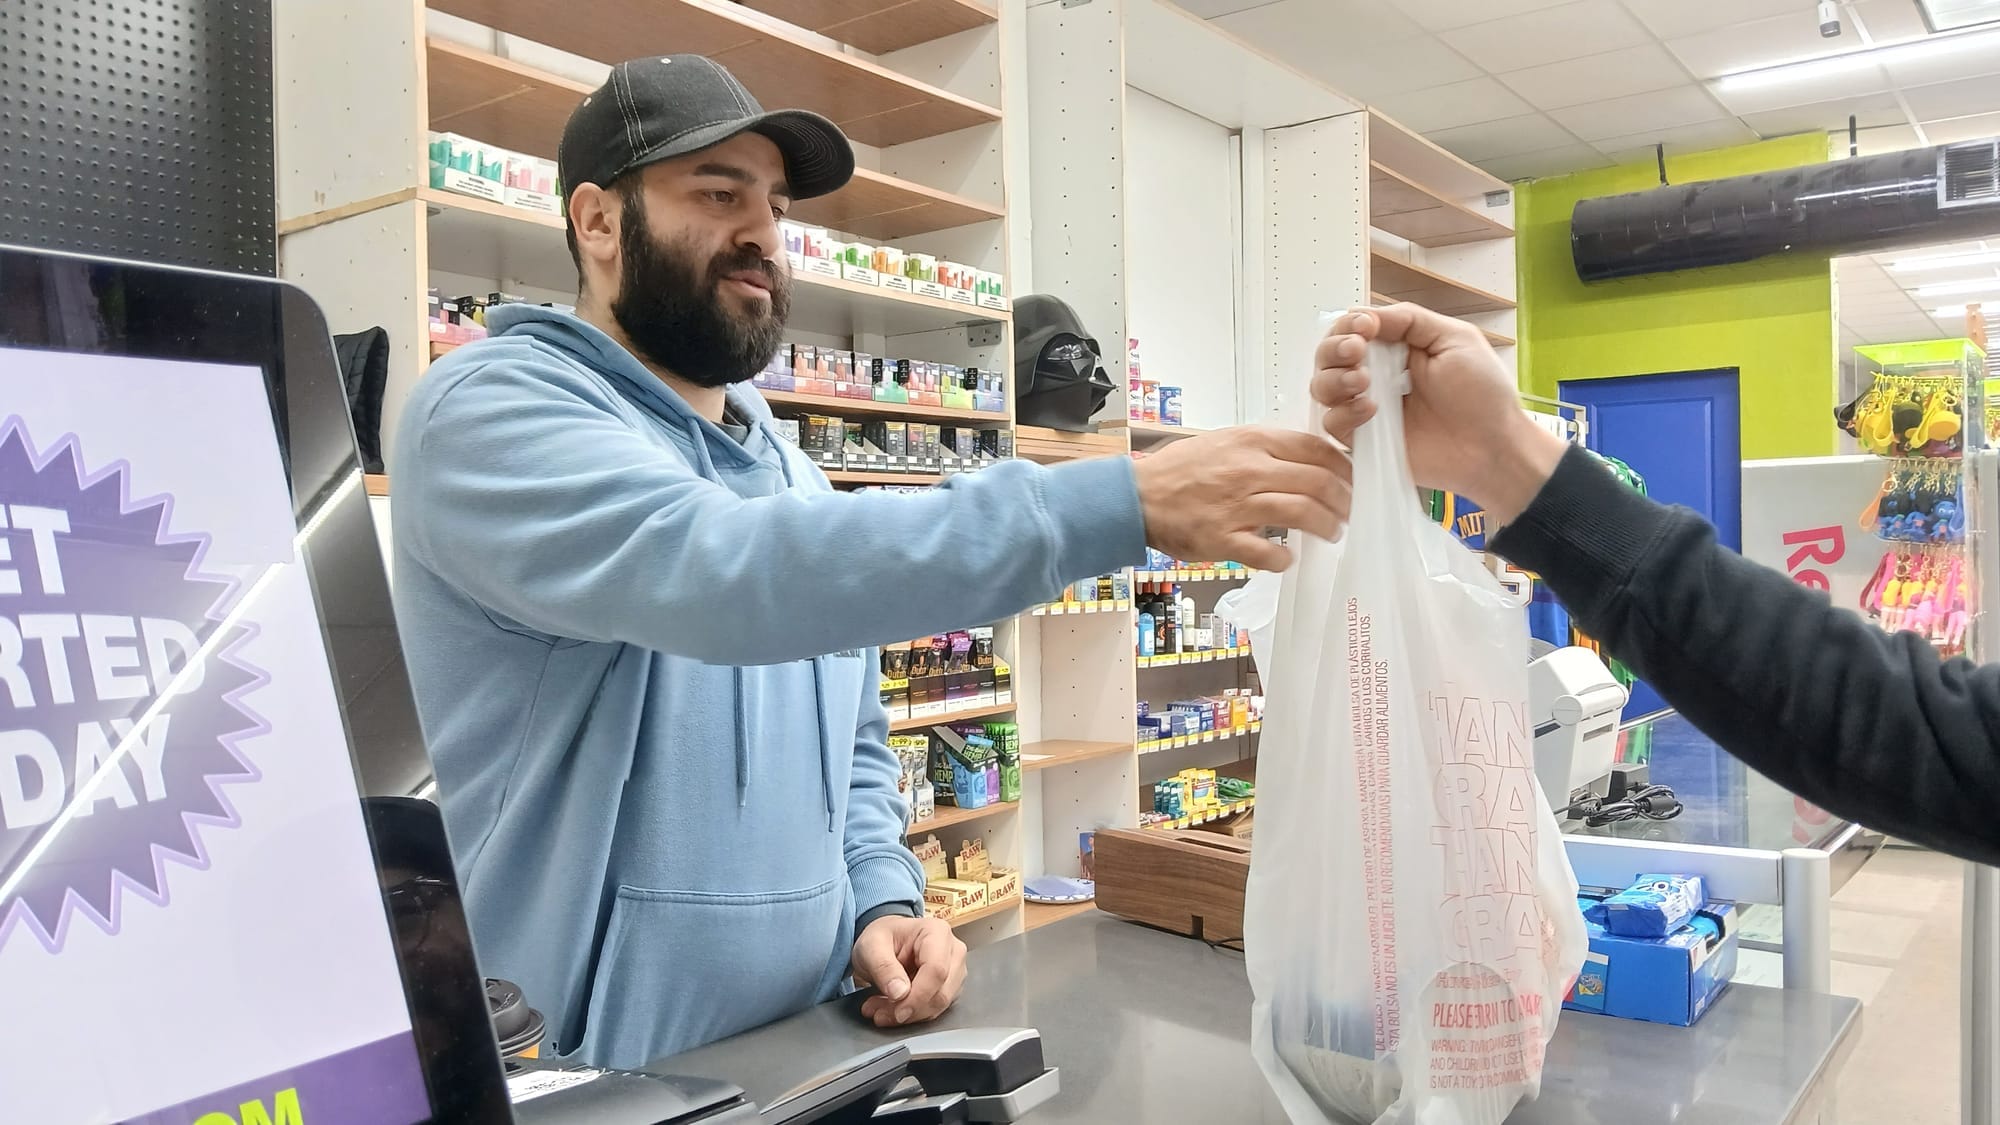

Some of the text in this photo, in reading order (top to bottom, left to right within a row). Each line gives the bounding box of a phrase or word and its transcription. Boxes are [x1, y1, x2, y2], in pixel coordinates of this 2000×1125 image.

[1347, 597, 1358, 627] LEJOS
[1360, 613, 1371, 675] CORRALITOS.
[1350, 675, 1359, 689] DE
[1361, 676, 1372, 695] LOS
[1375, 659, 1389, 717] ALIMENTOS.
[1351, 690, 1361, 722] BOLSA
[1362, 697, 1372, 706] O
[1376, 718, 1390, 766] GUARDAR
[0, 713, 172, 830] DAY
[1377, 767, 1391, 793] PARA
[1379, 794, 1393, 877] RECOMENDADAS
[961, 843, 981, 861] RAW
[995, 880, 1016, 899] RAW
[1381, 879, 1393, 894] NO
[961, 889, 984, 908] RAW
[1383, 943, 1396, 959] UN
[1384, 960, 1397, 974] ES
[1385, 975, 1398, 991] NO
[1387, 993, 1401, 1027] BOLSA
[1389, 1028, 1401, 1053] ESTA
